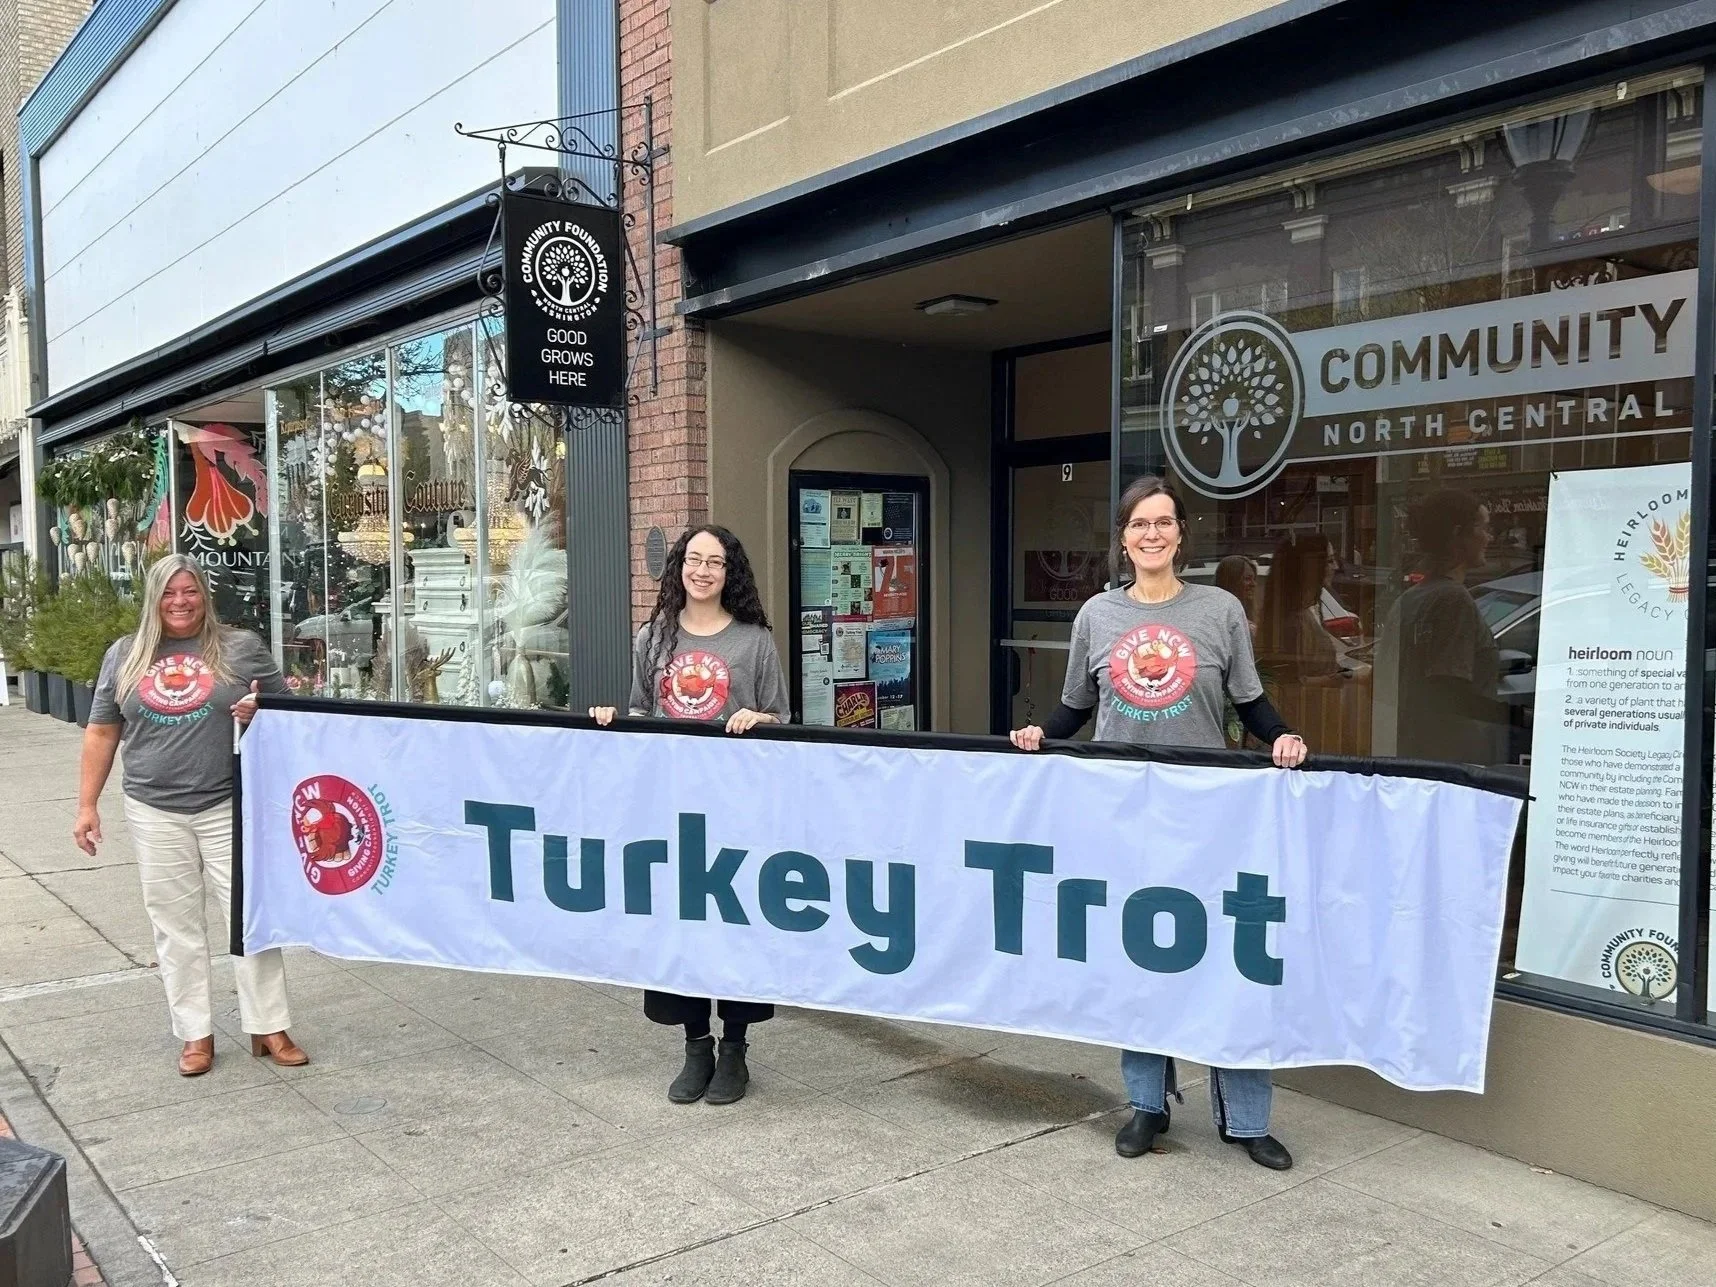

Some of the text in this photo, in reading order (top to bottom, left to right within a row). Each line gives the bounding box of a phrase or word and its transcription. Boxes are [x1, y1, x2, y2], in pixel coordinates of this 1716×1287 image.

[521, 220, 609, 293] COMMUNITY FOUNDATION
[535, 298, 598, 322] WASHINGTON
[543, 297, 591, 314] NORTH CENTRAL
[547, 328, 587, 345] GOOD
[1319, 297, 1688, 394] COMMUNITY
[541, 348, 594, 367] GROWS
[549, 370, 587, 387] HERE
[1323, 390, 1674, 447] NORTH CENTRAL
[1063, 464, 1072, 481] 9
[402, 470, 470, 514] Couture
[1614, 488, 1689, 561] HEIRLOOM
[188, 551, 299, 569] MOUNTAN
[1616, 572, 1674, 621] LEGACY
[880, 644, 901, 654] MARY
[1115, 628, 1192, 660] GIVE NCW
[875, 652, 907, 664] POPPINS
[1568, 646, 1673, 661] heirloom noun
[145, 657, 176, 677] GIVE
[701, 655, 728, 680] NCW
[1629, 668, 1639, 677] of
[1640, 668, 1675, 680] special
[1144, 676, 1183, 699] CAMPAIGN
[1566, 679, 1588, 688] from
[1589, 681, 1607, 689] one
[1609, 680, 1660, 691] generation
[1662, 682, 1672, 690] to
[836, 692, 869, 717] CHARLIE
[1111, 694, 1193, 721] TURKEY TROT
[1585, 695, 1617, 708] variety
[1618, 697, 1629, 707] of
[1630, 697, 1654, 708] plant
[1656, 698, 1676, 708] that
[137, 704, 183, 725] TURKEY
[184, 701, 214, 722] TROT
[1564, 707, 1597, 717] several
[1599, 709, 1656, 720] generations
[1563, 719, 1574, 728] of
[1574, 719, 1607, 730] private
[1562, 744, 1577, 754] The
[1577, 746, 1614, 756] Heirloom
[1615, 748, 1646, 760] Society
[1647, 750, 1672, 762] Legacy
[1561, 757, 1584, 766] those
[1584, 759, 1602, 768] who
[1602, 760, 1623, 769] have
[1674, 764, 1681, 772] a
[1559, 770, 1605, 782] community
[1605, 772, 1617, 783] by
[1617, 773, 1652, 785] including
[1559, 780, 1580, 790] NCW
[1589, 783, 1608, 792] their
[1608, 785, 1635, 795] estate
[1557, 804, 1575, 814] their
[1576, 806, 1602, 816] estate
[1558, 793, 1575, 802] who
[1576, 794, 1596, 803] have
[1596, 796, 1620, 806] made
[1620, 797, 1634, 807] the
[1662, 799, 1673, 809] to
[1556, 816, 1565, 825] or
[1566, 816, 1578, 826] life
[1579, 819, 1618, 830] insurance
[346, 795, 372, 878] GIVING CAMPAIGN
[367, 783, 399, 896] TURKEY TROT
[1555, 828, 1587, 839] become
[1587, 832, 1623, 842] members
[1554, 840, 1569, 850] The
[1570, 844, 1590, 853] word
[1553, 853, 1576, 866] giving
[1576, 855, 1589, 864] will
[1552, 864, 1579, 877] impact
[1579, 868, 1597, 879] your
[1621, 874, 1663, 885] charities
[463, 799, 1287, 987] Turkey Trot
[1600, 927, 1644, 979] COMMUNITY
